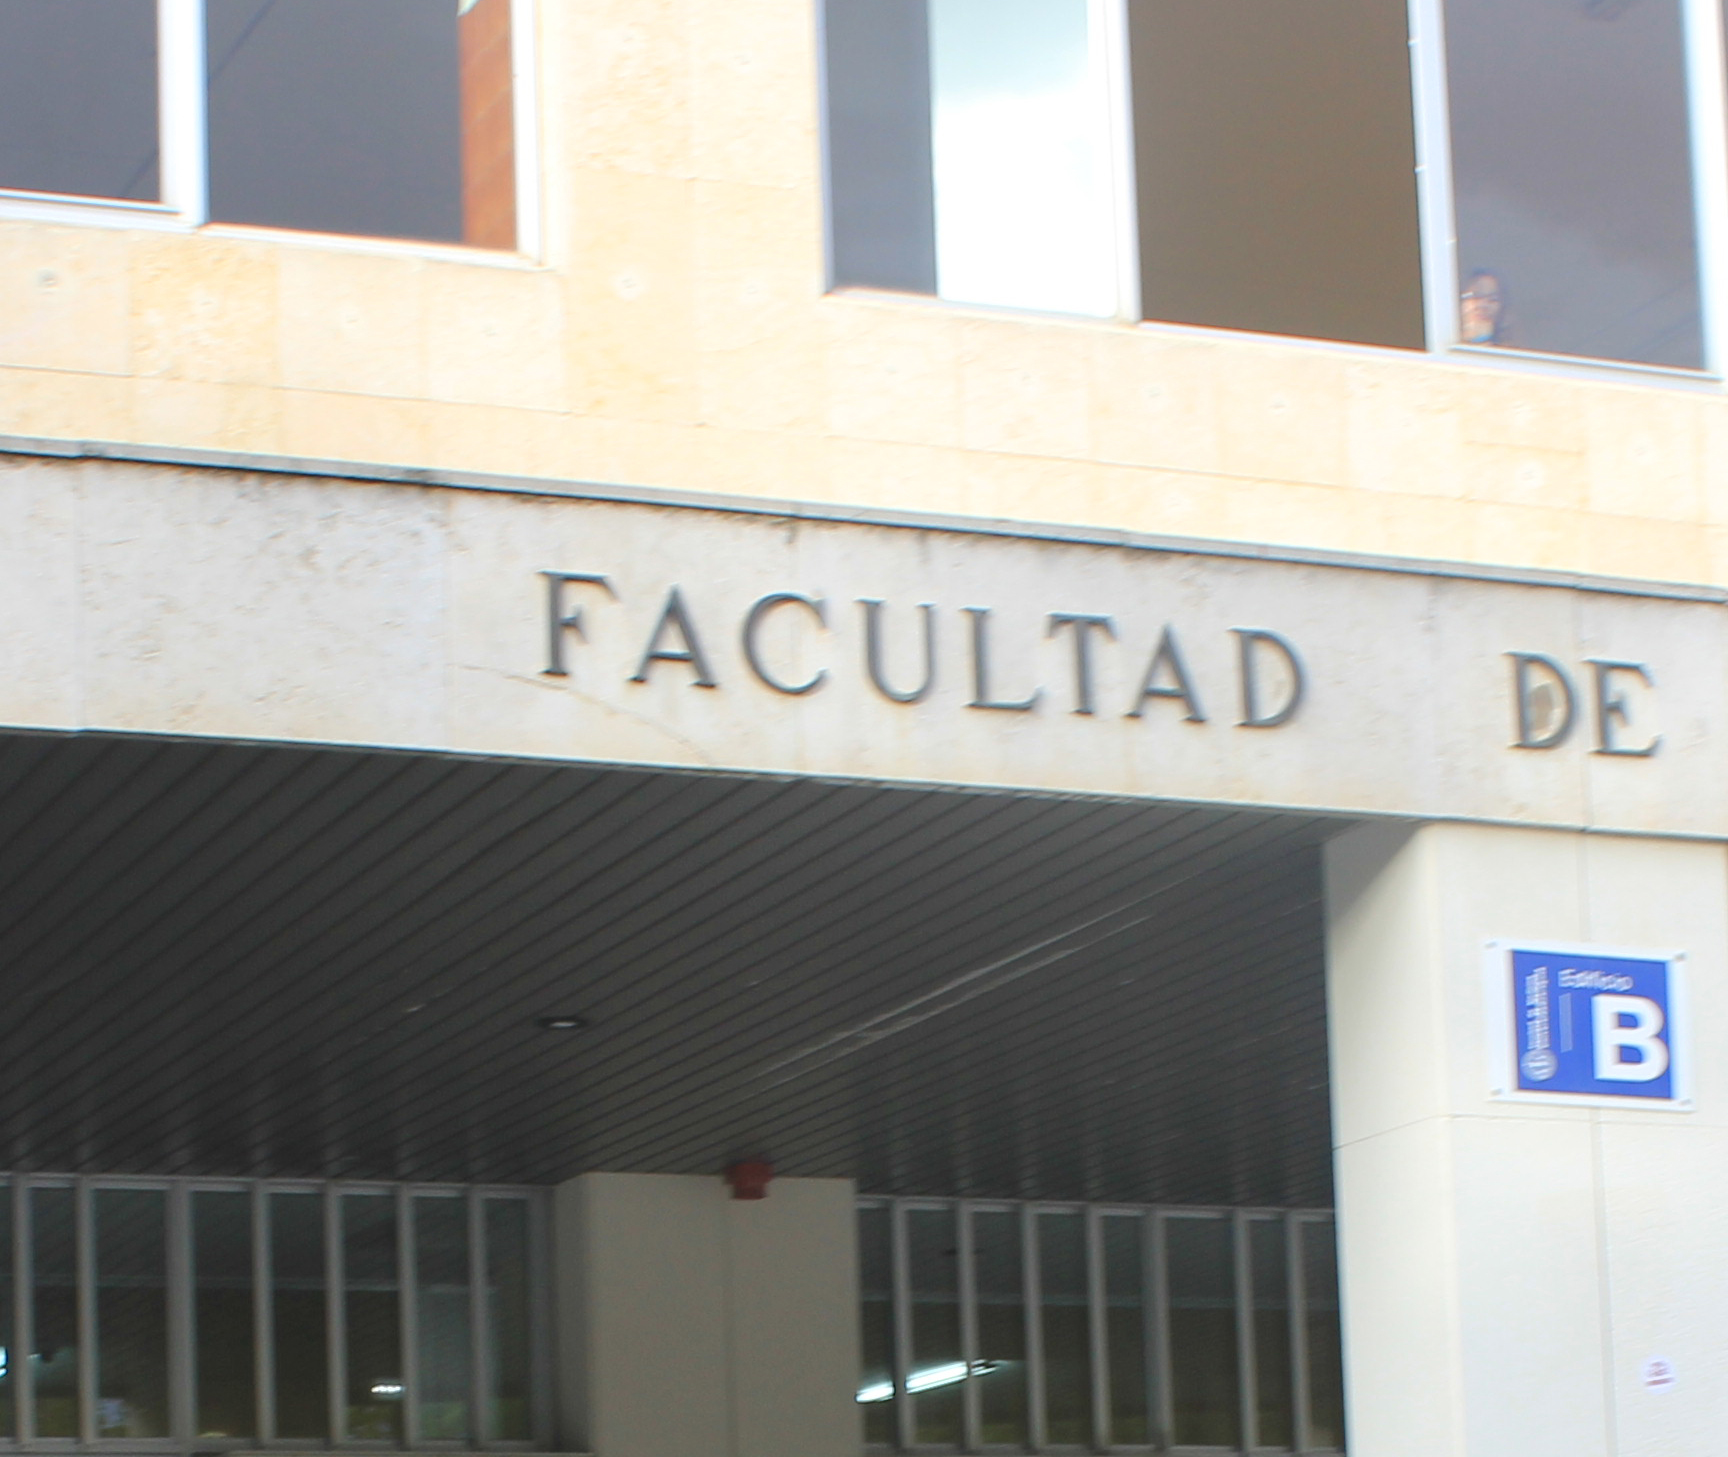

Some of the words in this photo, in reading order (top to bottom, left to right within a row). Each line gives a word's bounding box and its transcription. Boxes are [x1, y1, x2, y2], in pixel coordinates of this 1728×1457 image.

[536, 568, 1308, 729] FACULTAD
[1503, 650, 1664, 758] DE
[1558, 968, 1634, 992] Edificio
[1591, 993, 1670, 1084] B
